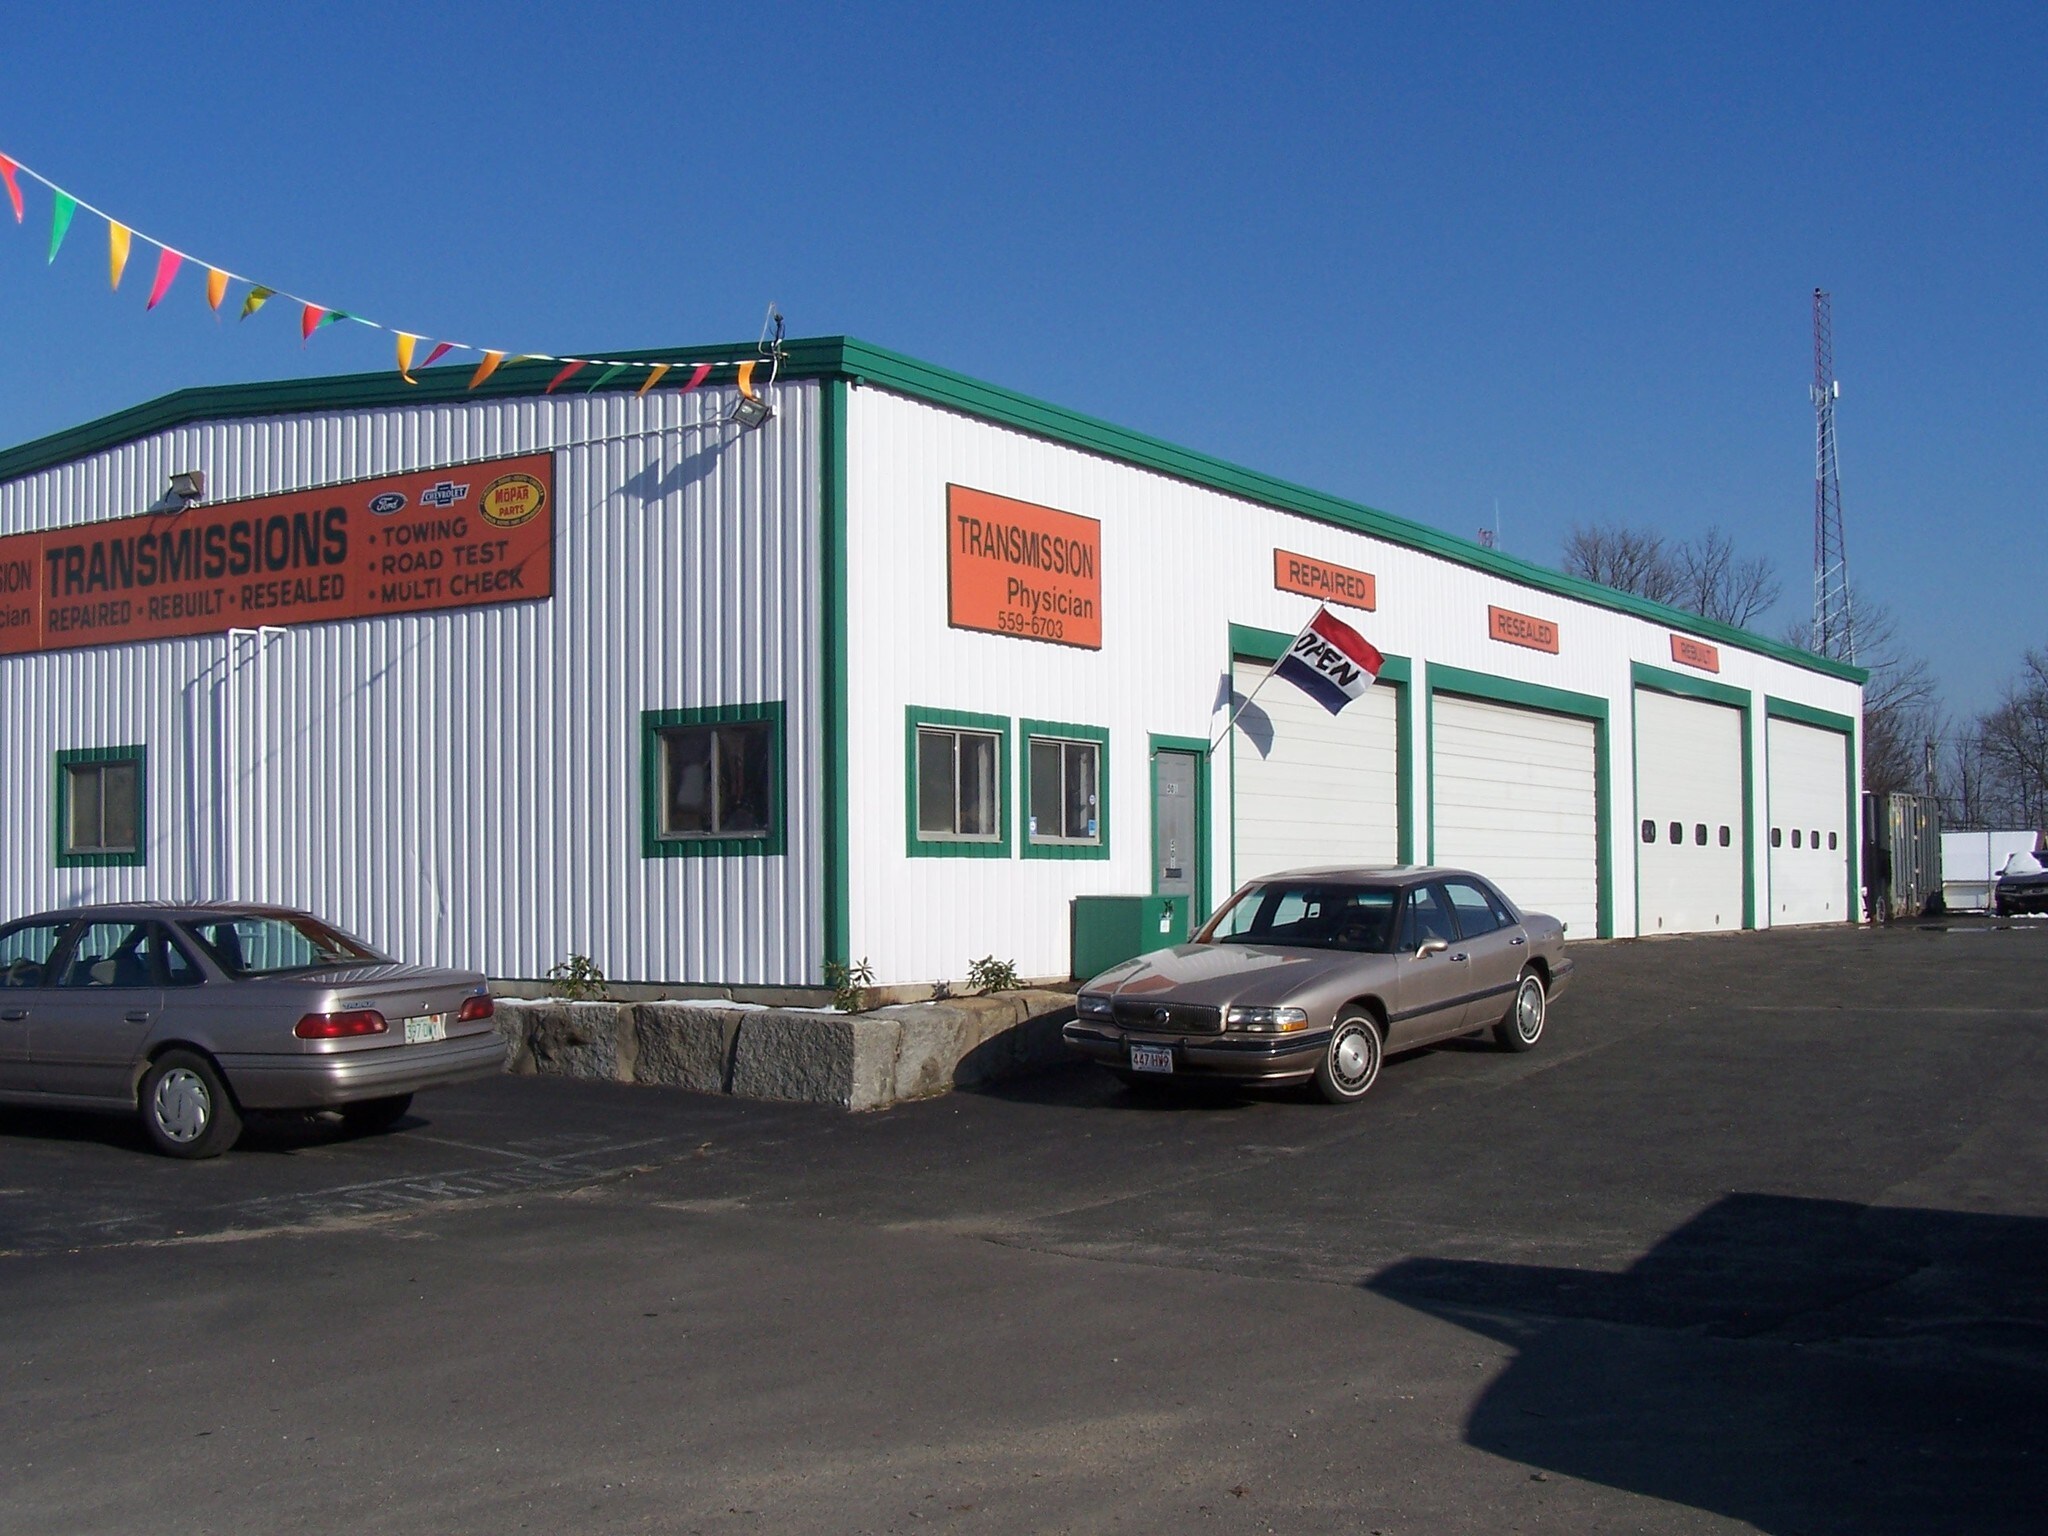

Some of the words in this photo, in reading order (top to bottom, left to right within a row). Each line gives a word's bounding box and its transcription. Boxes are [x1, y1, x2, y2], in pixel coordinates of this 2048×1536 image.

[376, 496, 399, 512] Ford
[425, 488, 465, 501] CHEVROLET
[499, 505, 525, 518] PARTS
[382, 517, 468, 547] TOWING
[957, 515, 1094, 580] TRANSMISSION
[46, 506, 348, 598] TRANSMISSIONS
[382, 549, 444, 576] ROAD
[452, 541, 509, 566] TEST
[381, 578, 442, 603] MULTI
[450, 565, 525, 596] CHECK
[1289, 560, 1366, 599] REPAIRED
[48, 600, 132, 633] REPAIRED
[148, 588, 225, 621] REBUILT
[241, 573, 345, 611] RESEALED
[1007, 577, 1094, 619] Physician
[998, 611, 1064, 639] 559-6703
[1498, 614, 1553, 645] RESEALED
[1293, 632, 1361, 687] OPEN
